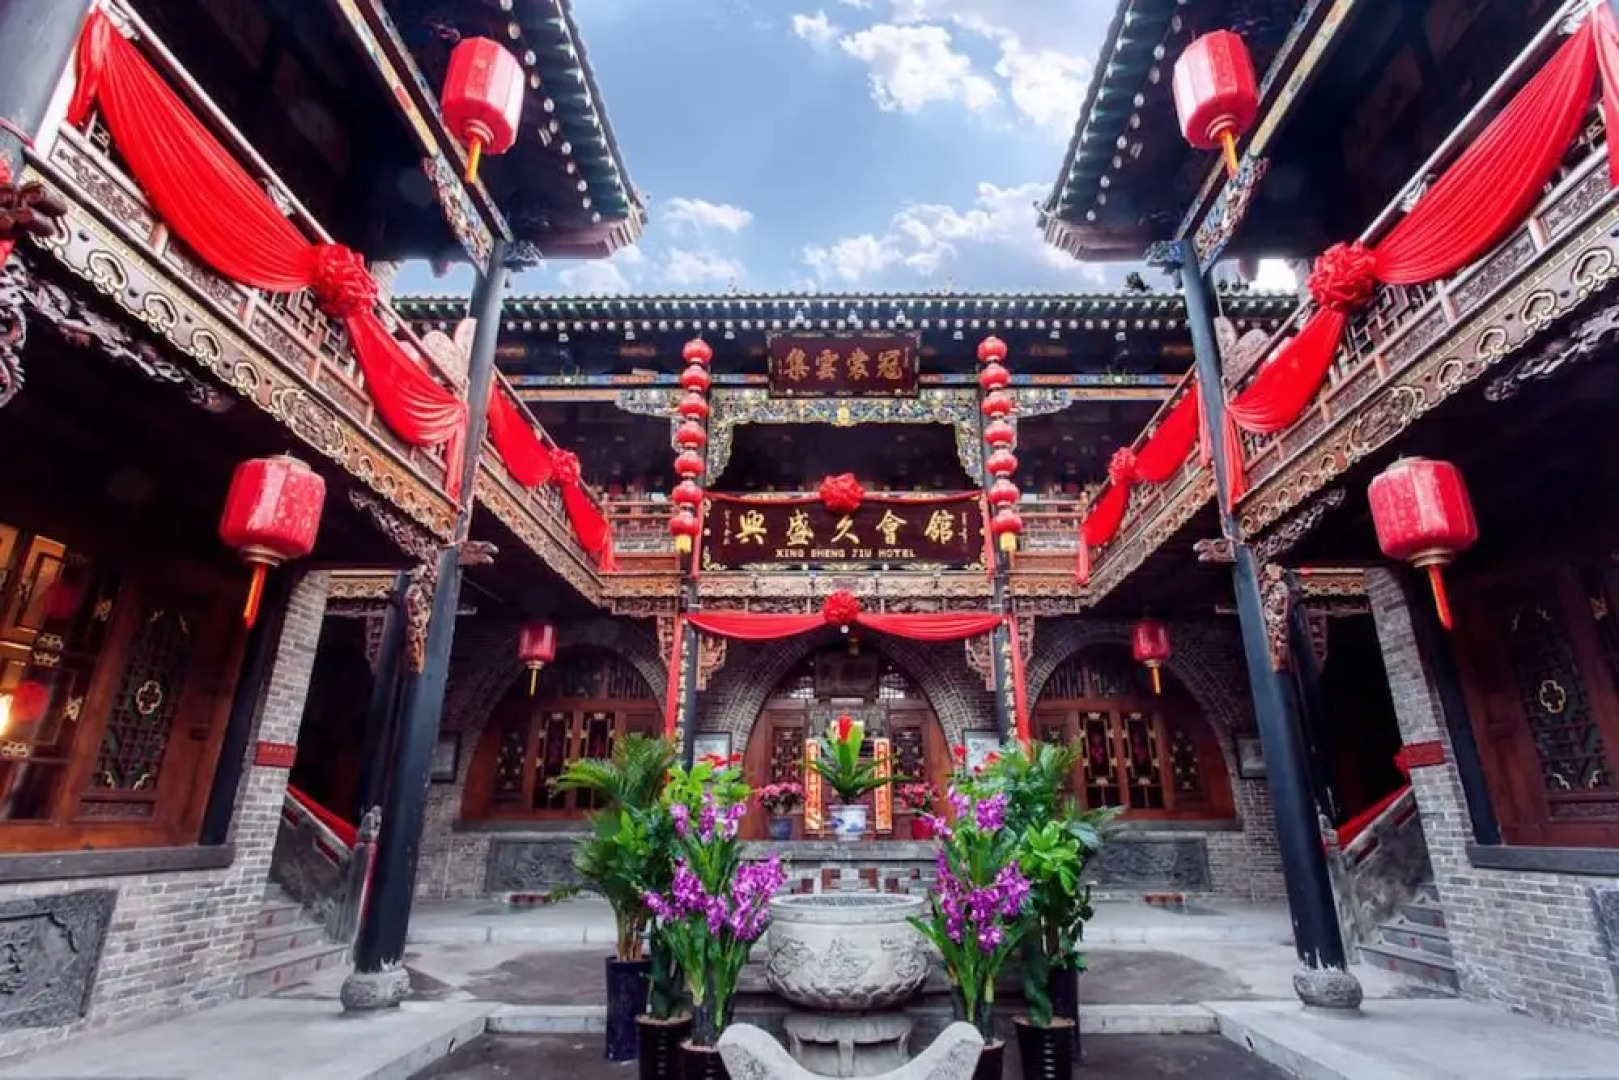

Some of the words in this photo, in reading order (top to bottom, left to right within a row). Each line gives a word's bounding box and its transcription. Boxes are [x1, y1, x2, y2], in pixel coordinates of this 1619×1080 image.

[775, 548, 805, 558] XING
[810, 548, 846, 558] SHENG
[851, 548, 872, 558] JIU
[878, 548, 916, 558] HOTEL
